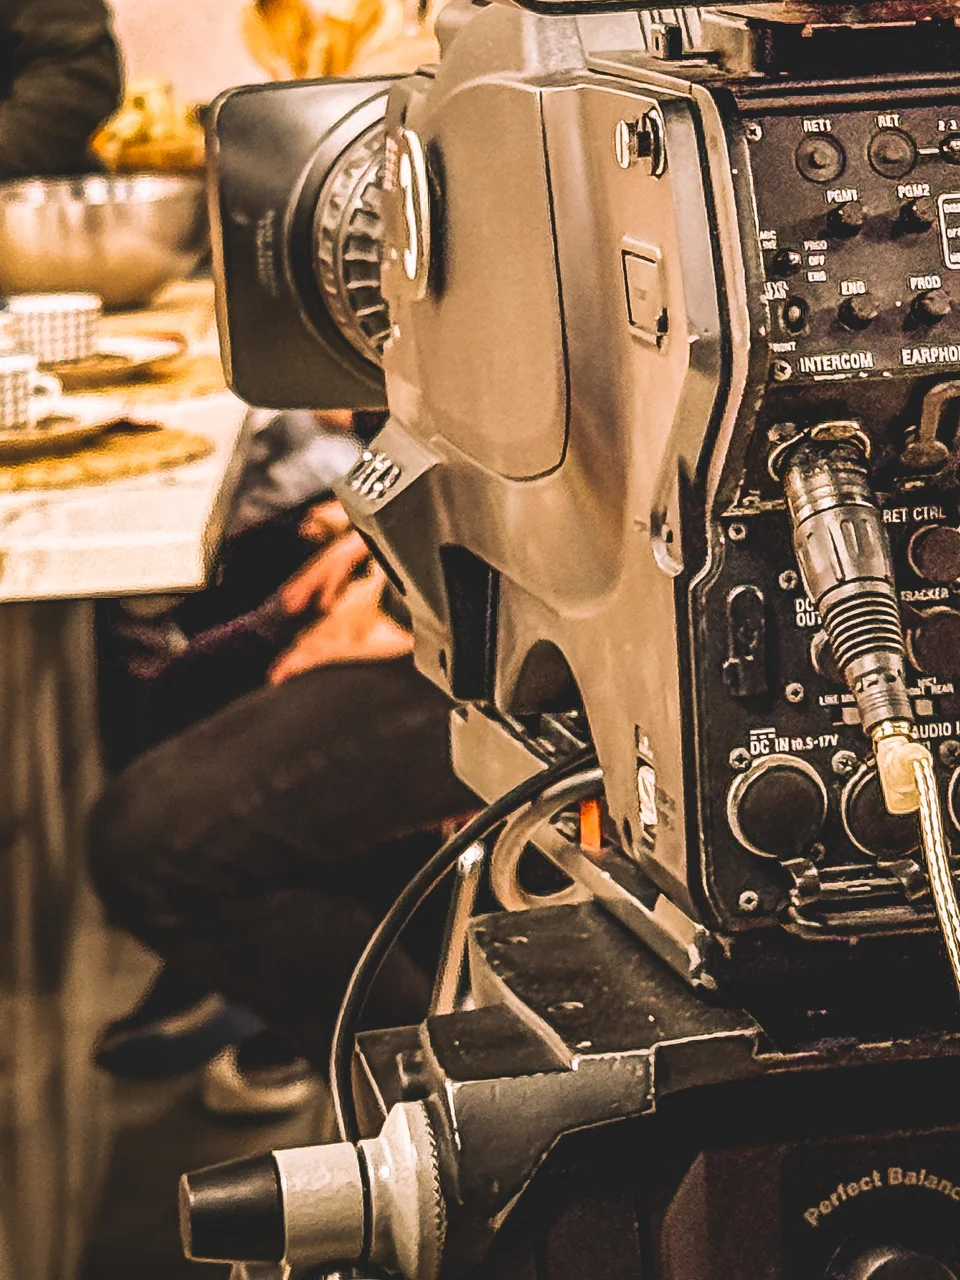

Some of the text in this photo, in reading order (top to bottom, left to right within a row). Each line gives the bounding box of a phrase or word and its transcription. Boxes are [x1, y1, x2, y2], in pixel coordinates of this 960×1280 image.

[897, 184, 930, 198] PGM2
[910, 275, 942, 290] PROD
[800, 352, 874, 372] INTERCOM
[883, 505, 947, 523] RET CTRL
[900, 587, 949, 602] TRACKER
[796, 611, 822, 626] OUT
[912, 722, 952, 739] AUDIO
[751, 739, 769, 755] DC
[775, 737, 789, 752] IN
[803, 1169, 882, 1227] Perfect
